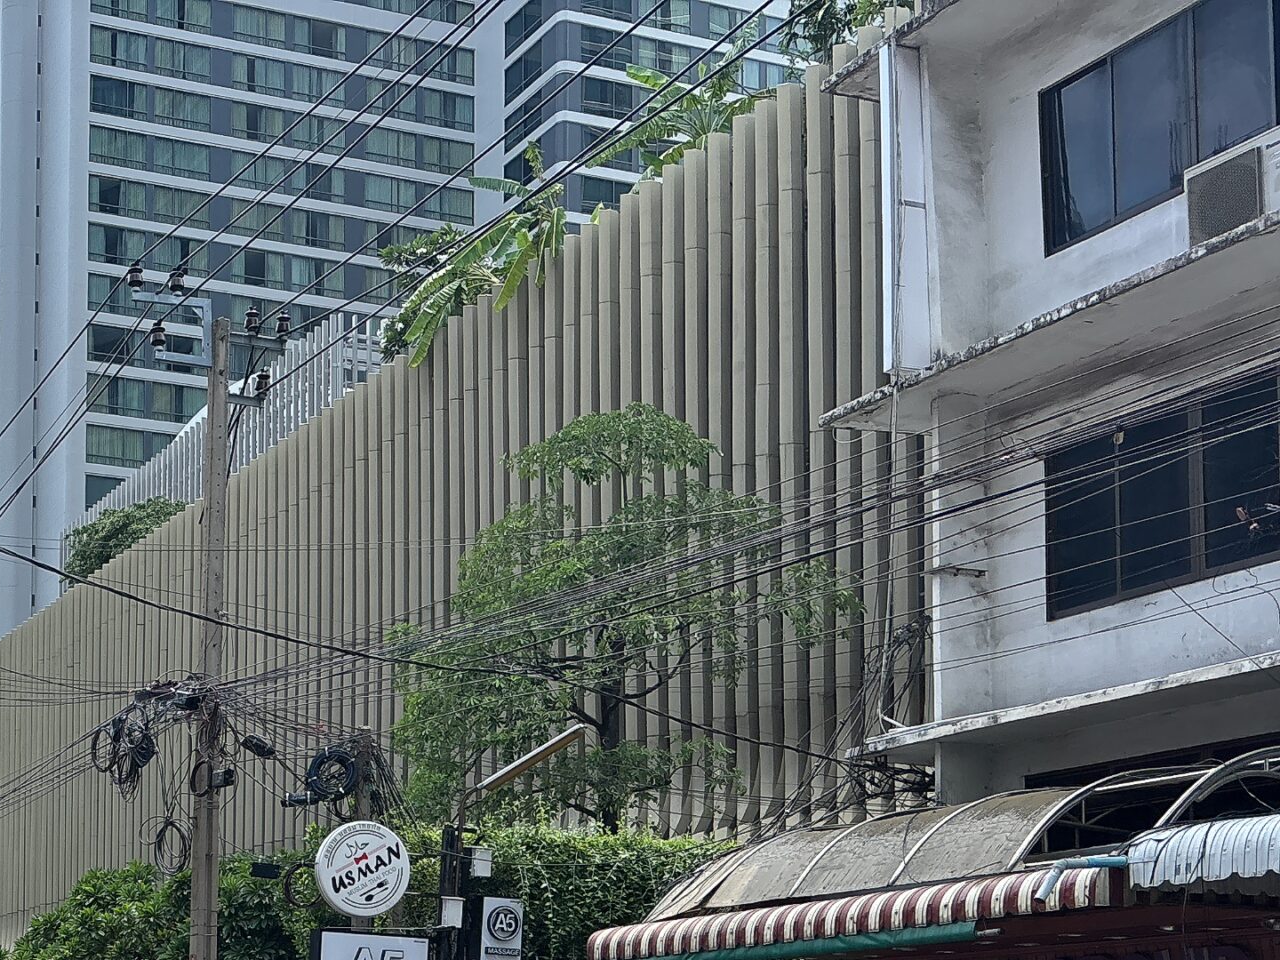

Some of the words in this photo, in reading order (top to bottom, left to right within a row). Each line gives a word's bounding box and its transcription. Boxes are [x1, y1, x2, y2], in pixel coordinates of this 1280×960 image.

[331, 841, 401, 894] USMAN
[494, 913, 516, 932] A5
[485, 947, 520, 956] MASSAGE
